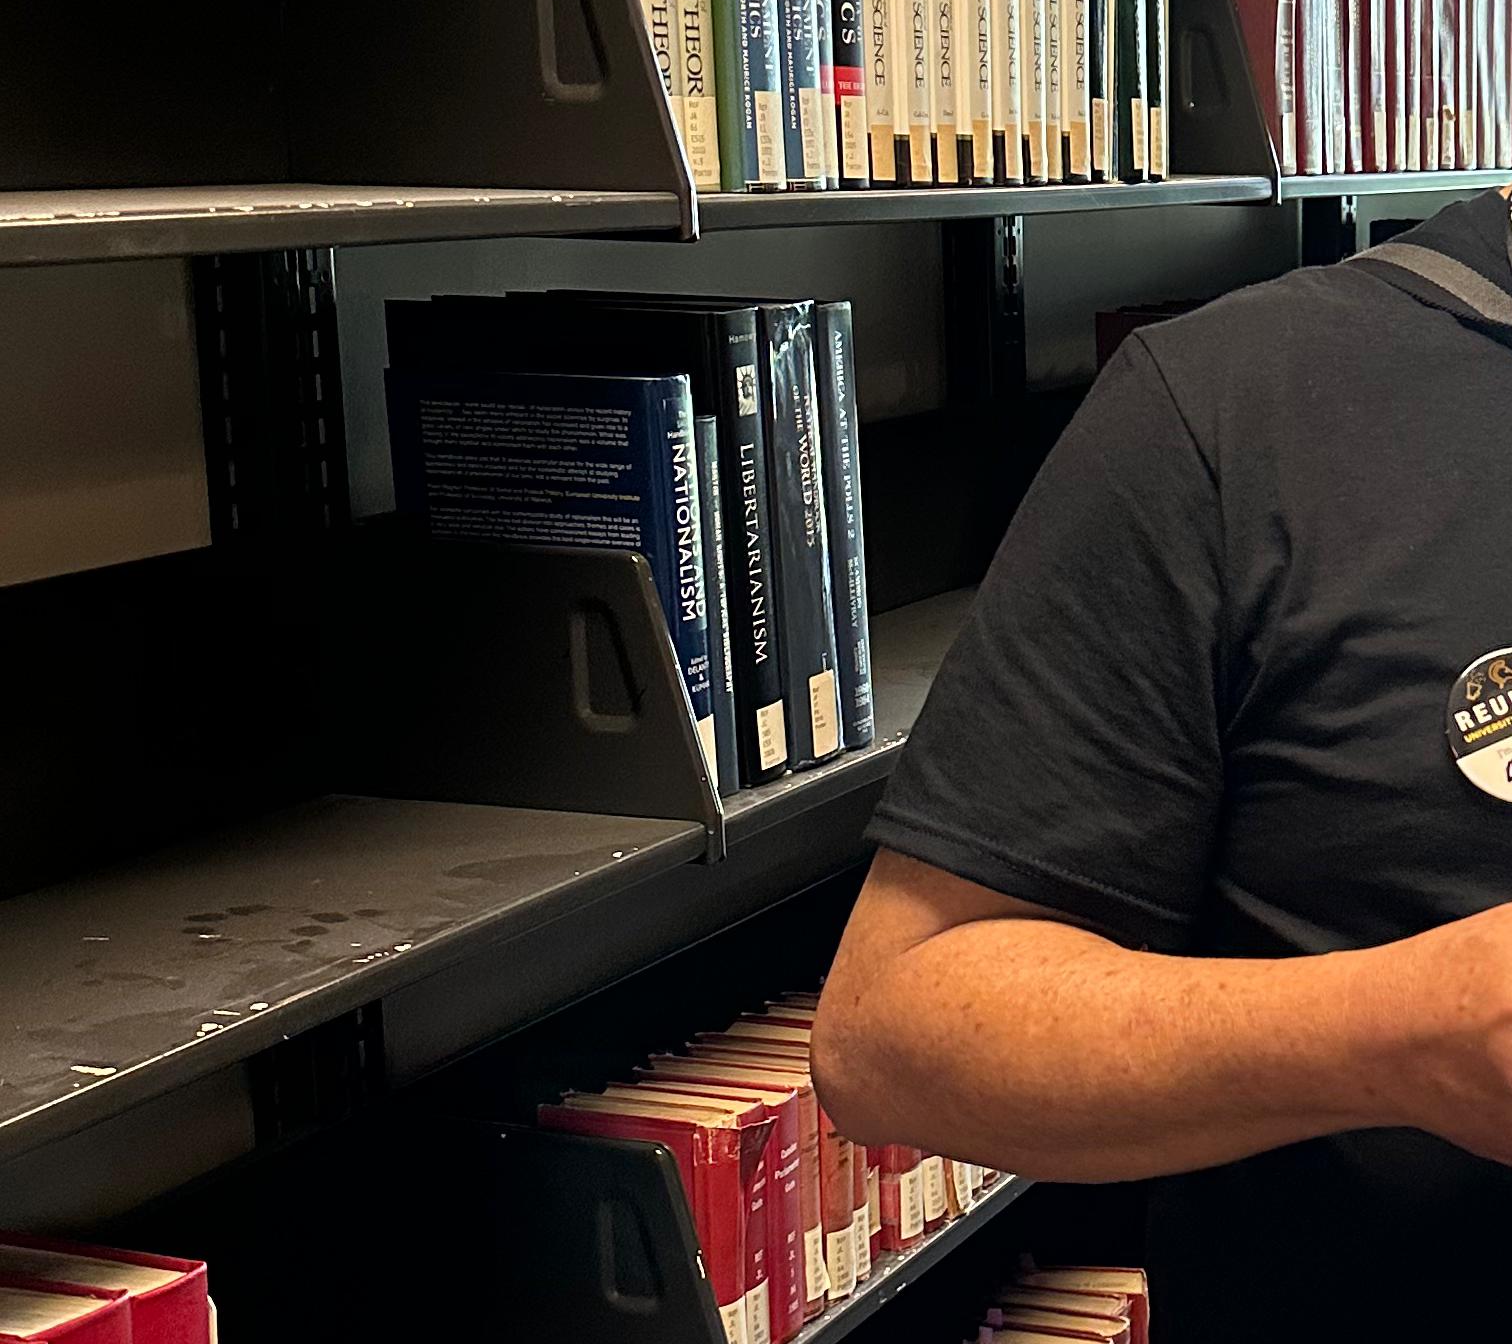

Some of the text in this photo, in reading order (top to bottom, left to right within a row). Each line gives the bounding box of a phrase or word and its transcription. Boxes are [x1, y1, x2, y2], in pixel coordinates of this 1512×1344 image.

[742, 48, 751, 92] MAURICE
[786, 50, 796, 93] MAURICE
[912, 1, 925, 89] SCIENCE
[939, 1, 952, 88] SCIENCE
[977, 5, 989, 91] SCIENCE
[1006, 3, 1017, 87] SCIENCE
[1032, 11, 1043, 93] SCIENCE
[1075, 11, 1086, 90] SCIENCE
[745, 93, 753, 129] KOGAN
[834, 330, 846, 403] AMERICA
[797, 434, 814, 505] WORLD
[840, 435, 850, 470] THE
[671, 444, 697, 623] NATIONALISM
[842, 476, 855, 524] POLLS
[740, 442, 769, 665] LIBERTARIANISM
